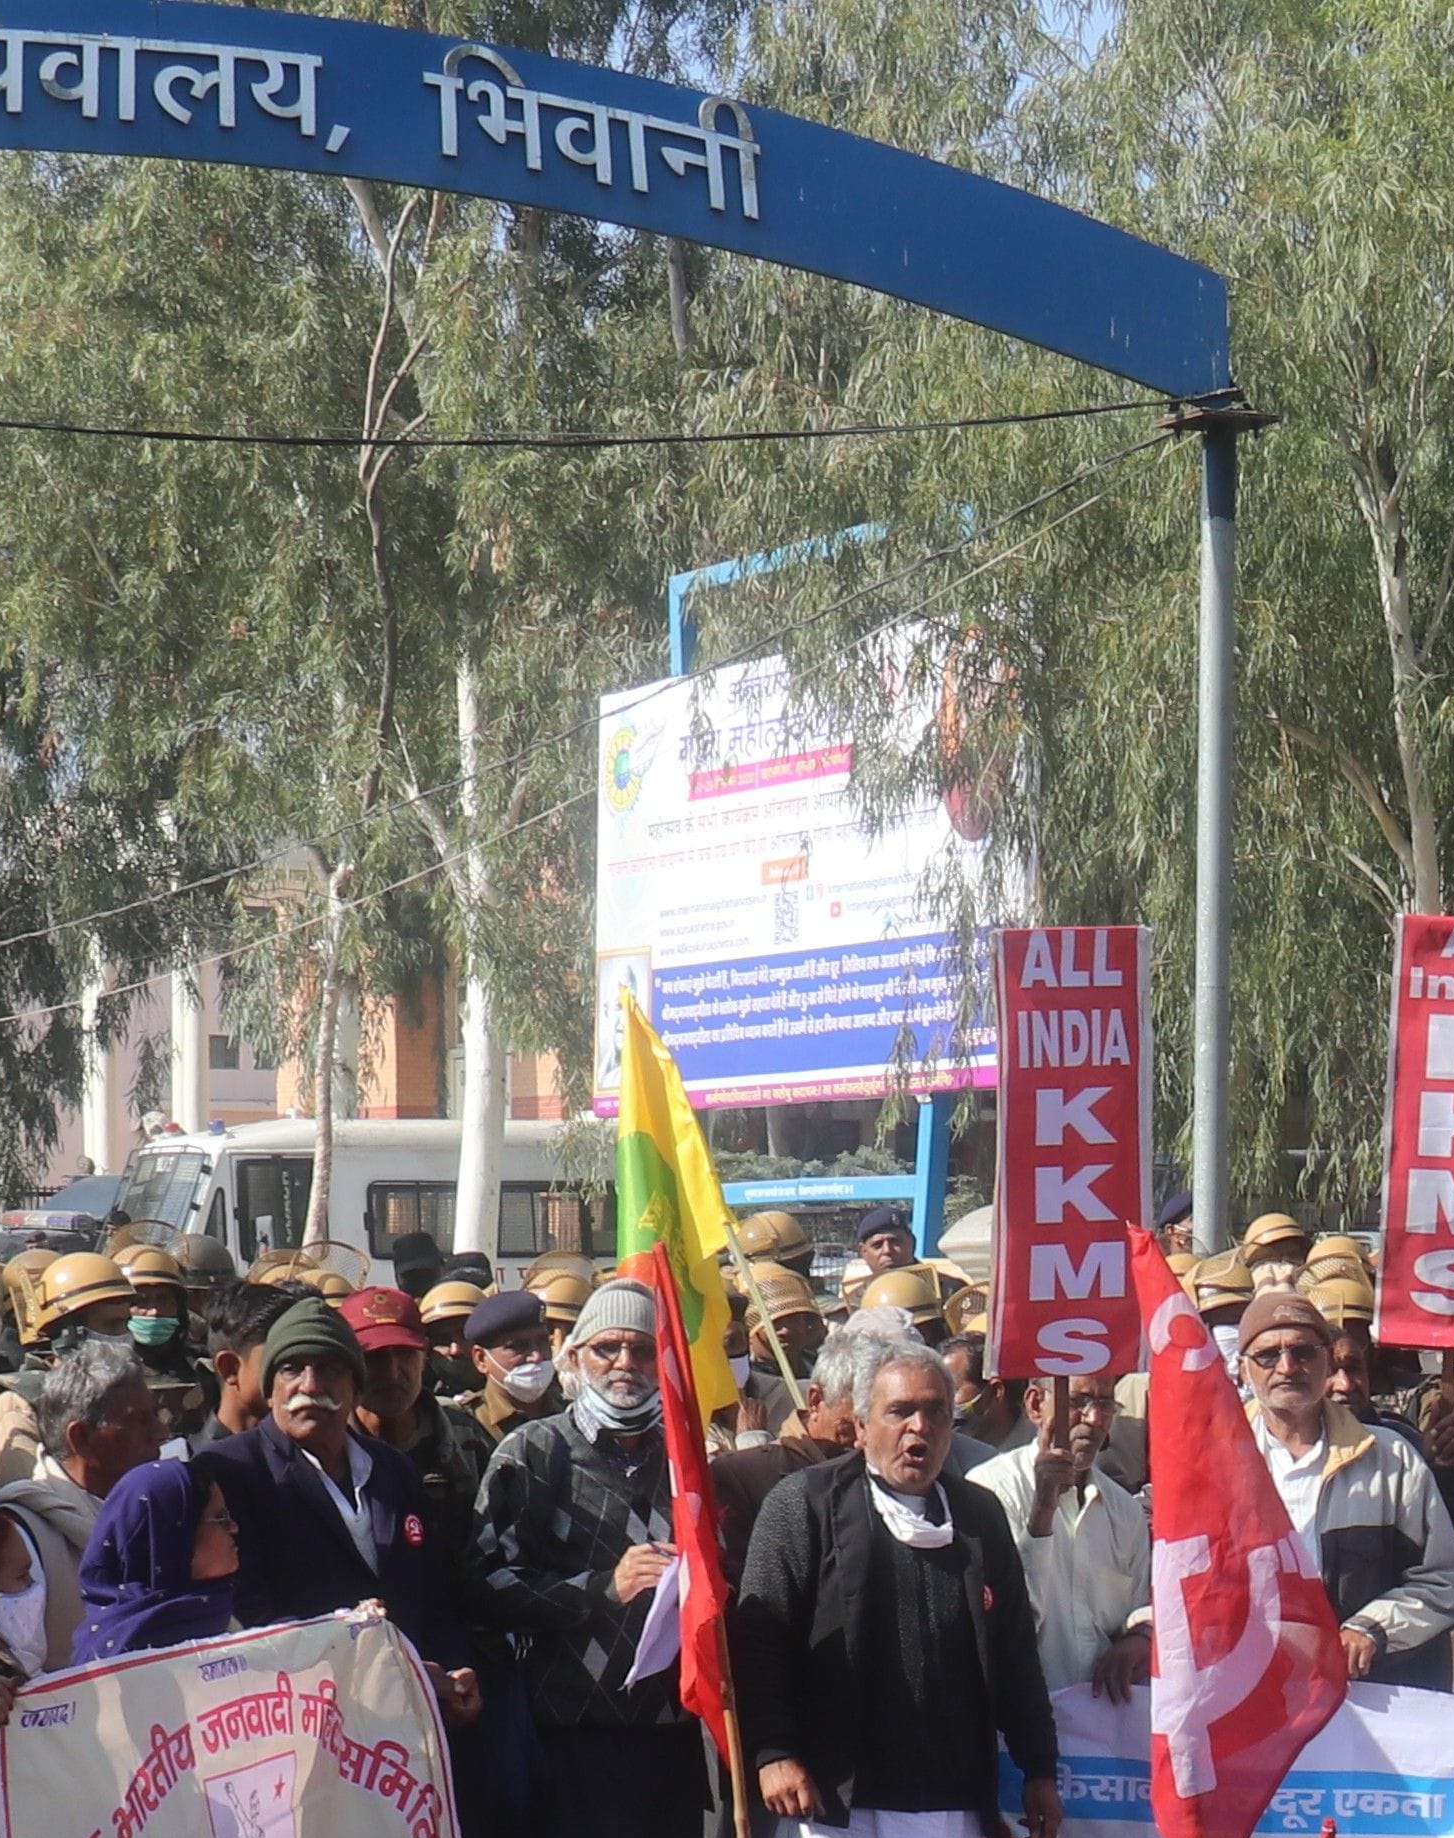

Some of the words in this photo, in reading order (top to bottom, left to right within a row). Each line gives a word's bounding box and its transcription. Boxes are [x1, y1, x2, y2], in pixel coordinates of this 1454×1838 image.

[422, 44, 761, 220] भिवानी
[1020, 930, 1123, 988] ALL
[1017, 1007, 1131, 1069] INDIA
[1028, 1085, 1127, 1376] KKMS
[197, 1671, 294, 1754] जनवादी
[1333, 1788, 1444, 1821] एकता
